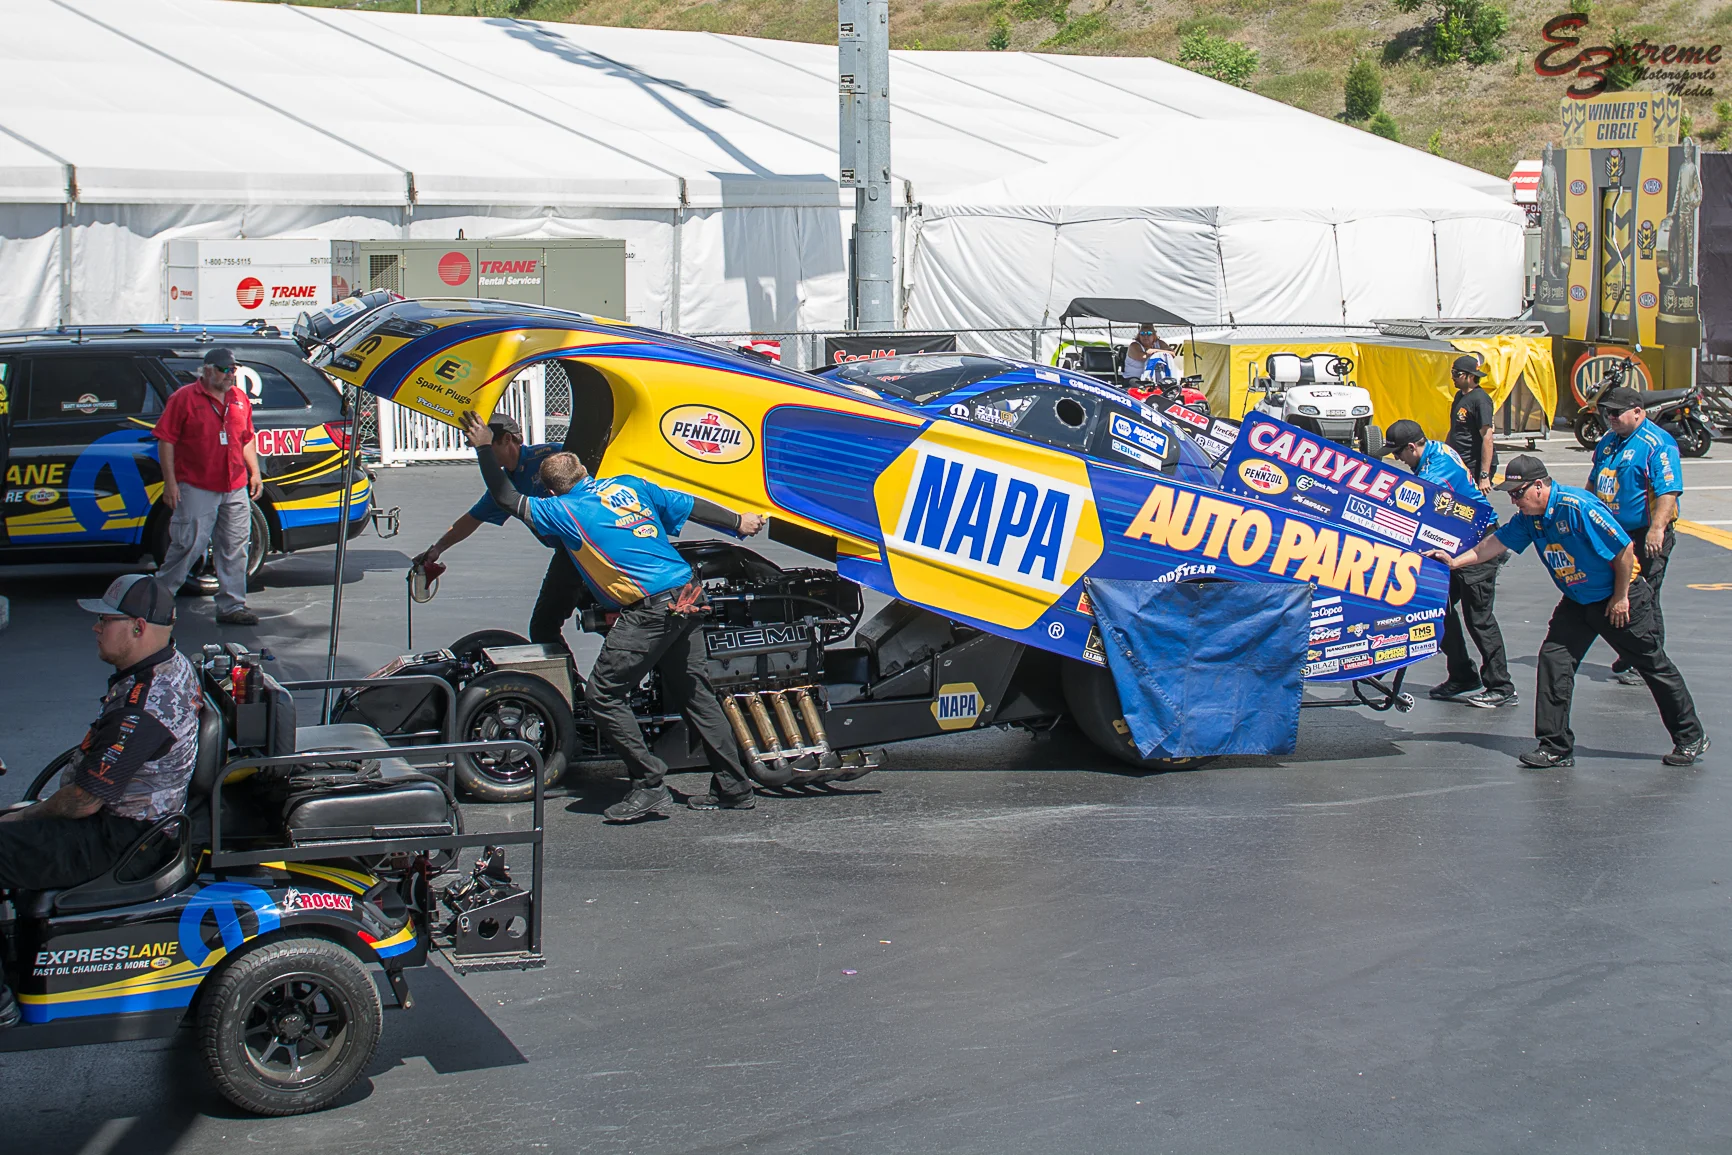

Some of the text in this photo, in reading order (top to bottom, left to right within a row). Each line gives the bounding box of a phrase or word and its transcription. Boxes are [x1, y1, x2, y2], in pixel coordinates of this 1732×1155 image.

[1588, 101, 1648, 121] WINNER'S
[1597, 122, 1639, 140] CIRCLE
[480, 260, 537, 274] TRANE
[478, 276, 541, 286] Rental Services
[271, 285, 317, 298] TRANE
[415, 376, 472, 405] Spark Plugs
[976, 413, 1012, 427] TACTICAL
[1167, 404, 1209, 425] ARP
[671, 418, 742, 446] PENNZOIL
[1248, 422, 1400, 502] CARLYLE
[1244, 467, 1283, 485] PENNZOIL
[1399, 487, 1421, 507] NAPA
[903, 454, 1070, 582] NAPA
[1350, 500, 1372, 518] USA
[1343, 512, 1412, 544] COMPRESSION
[1123, 482, 1422, 607] AUTO PARTS
[1421, 529, 1455, 548] Mastercam
[1319, 606, 1343, 618] Copco
[1405, 607, 1446, 623] OKUMA
[707, 625, 808, 651] HEMI
[1412, 626, 1431, 636] TMS
[1312, 660, 1337, 670] BLAZE
[938, 693, 978, 718] NAPA
[301, 893, 353, 911] ROCKY
[35, 941, 179, 966] EXPRESSLANE
[32, 959, 149, 976] FAST OIL CHANGES & MORE
